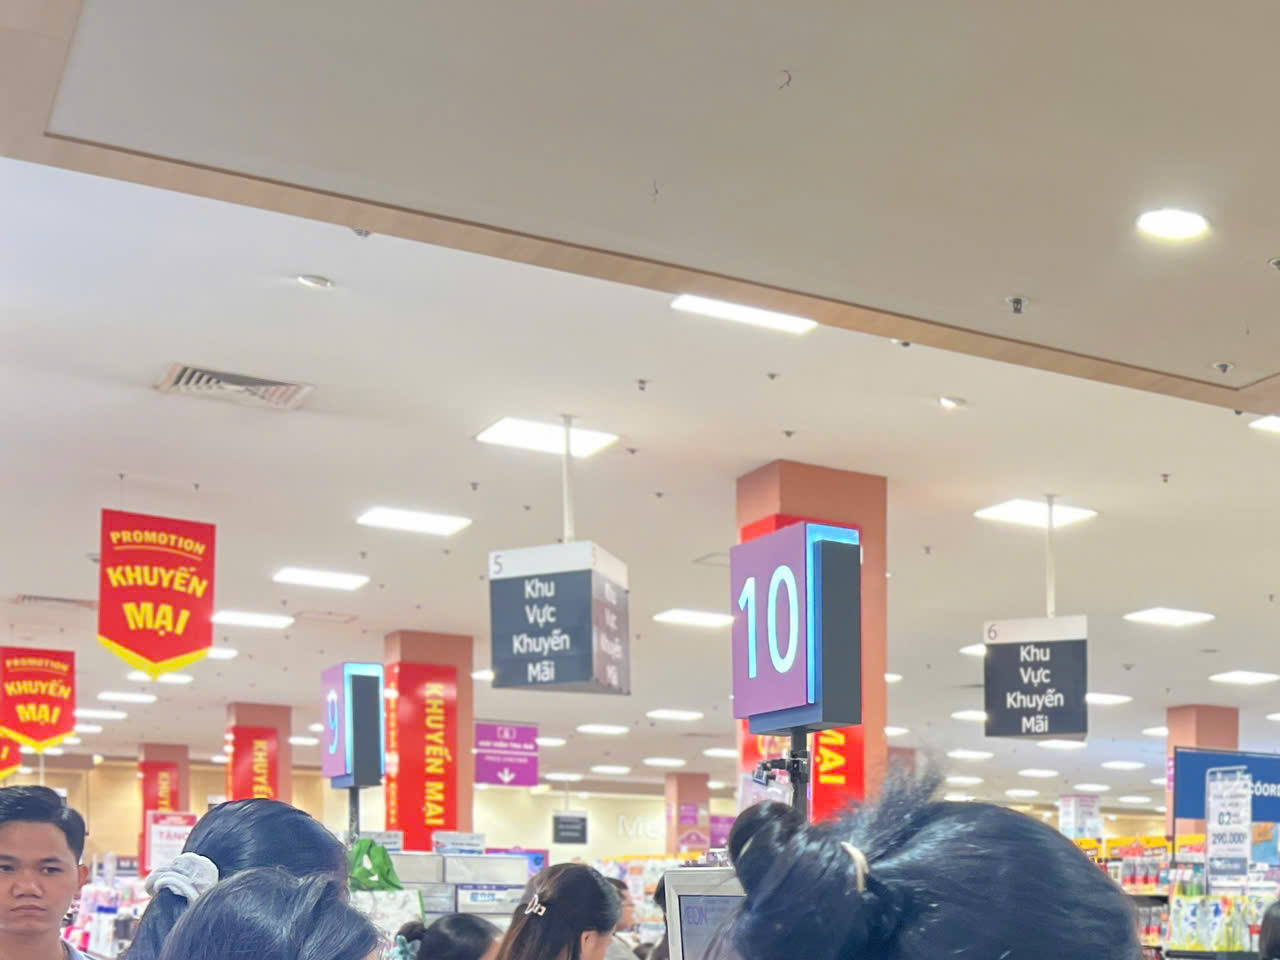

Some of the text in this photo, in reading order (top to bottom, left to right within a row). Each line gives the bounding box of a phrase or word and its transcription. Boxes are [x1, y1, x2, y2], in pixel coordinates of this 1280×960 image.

[110, 530, 206, 555] PROMOTION
[494, 554, 503, 575] 5
[106, 565, 208, 598] KHUYẾN
[524, 578, 555, 599] Khu
[122, 602, 191, 636] MẠI
[525, 603, 556, 628] Vực
[738, 565, 799, 679] 10
[987, 623, 997, 640] 6
[1020, 644, 1050, 662] Khu
[528, 660, 555, 682] Mãi
[1020, 666, 1050, 687] Vực
[327, 689, 340, 756] 9
[1021, 714, 1048, 733] Mãi
[422, 682, 451, 826] KHUYẾN MẠI
[252, 739, 274, 799] KHUYẾ
